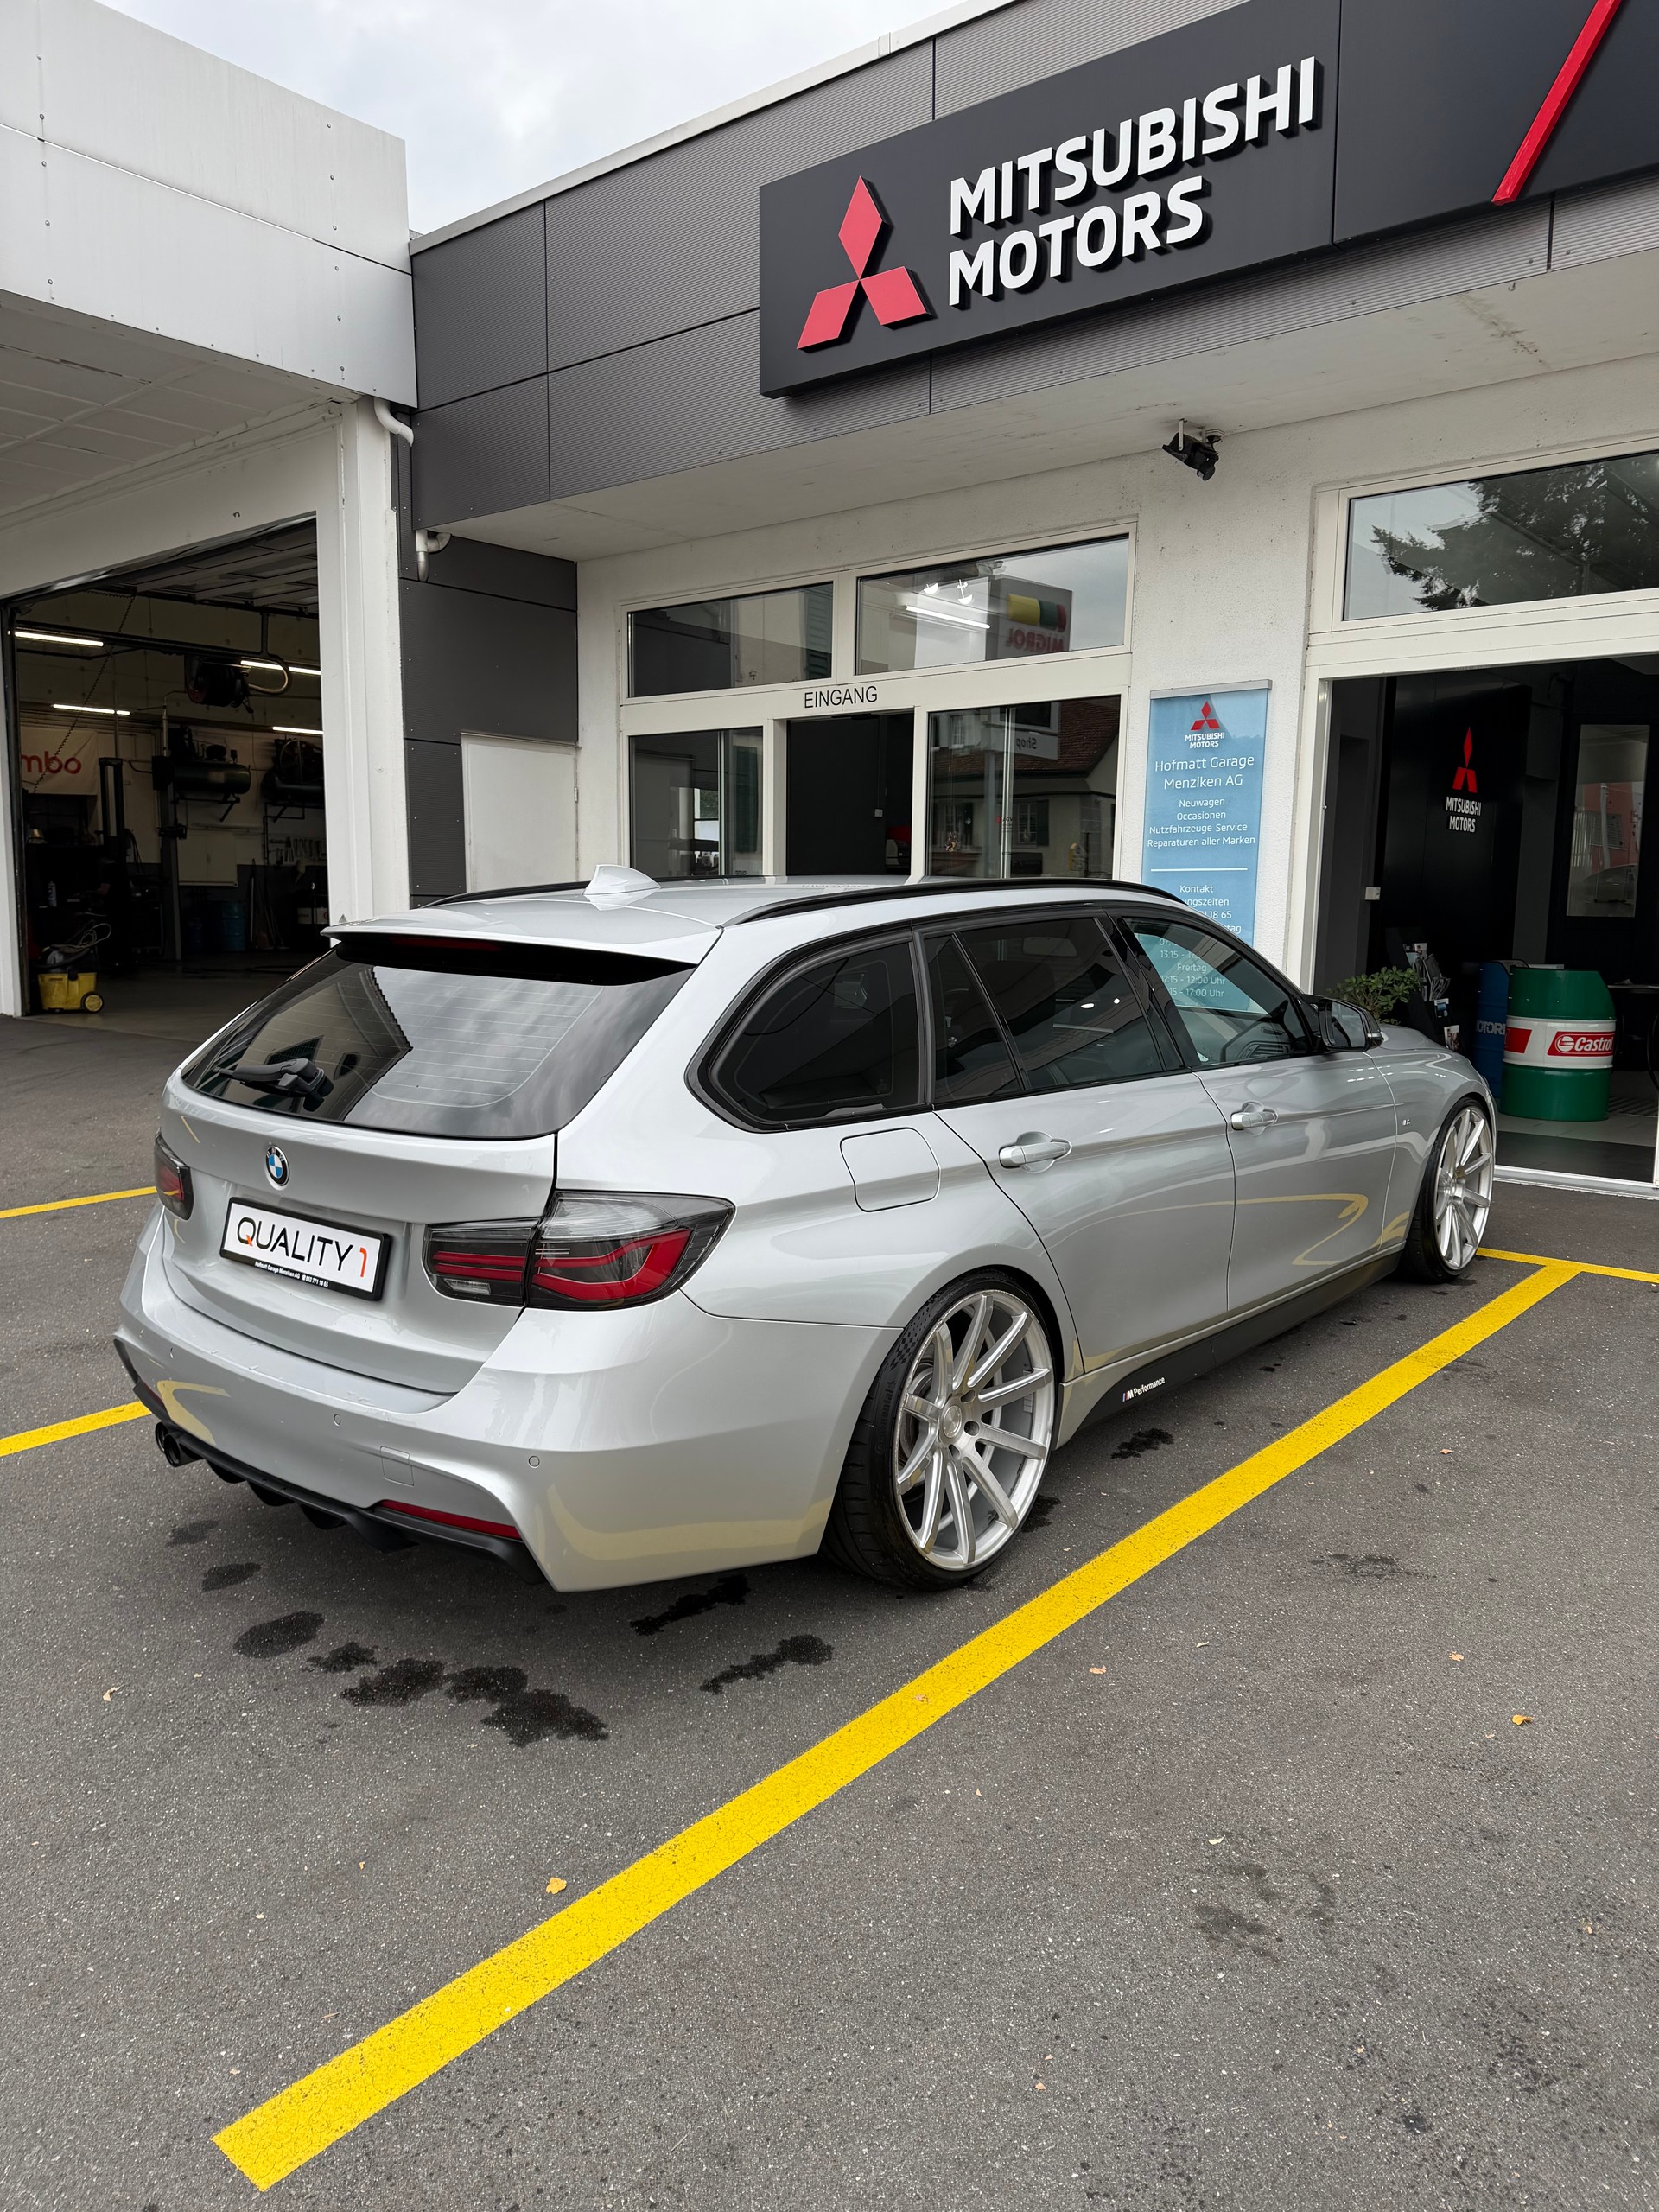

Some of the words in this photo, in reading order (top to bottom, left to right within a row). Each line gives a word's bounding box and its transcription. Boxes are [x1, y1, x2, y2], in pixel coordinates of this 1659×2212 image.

[950, 56, 1317, 236] MITSUBISHI
[949, 176, 1205, 307] MOTORS
[804, 685, 878, 709] EINGANG
[1185, 732, 1225, 741] MITSUBISHI
[1190, 741, 1219, 749] MOTORS
[1155, 758, 1207, 772] Hofmatt
[1210, 756, 1255, 770] Garage
[1164, 776, 1222, 790] Menziken
[1225, 774, 1243, 786] AG
[1179, 798, 1225, 809] Neuwagen
[1446, 796, 1482, 816] MITSUBISHI
[1177, 811, 1226, 821] Occasionen
[1149, 824, 1212, 835] Nutzfahrzeuge
[1215, 823, 1248, 832] Service
[1449, 815, 1476, 833] MOTORS
[1147, 838, 1199, 849] Reparaturen
[1201, 837, 1219, 846] aller
[1223, 836, 1255, 845] Marken
[1179, 885, 1214, 893] Kontakt
[1221, 911, 1232, 919] 65
[1177, 963, 1207, 973] Freitag
[1187, 976, 1208, 984] 12:00
[1211, 976, 1225, 985] Uhr
[1185, 988, 1207, 997] 17:00
[1209, 988, 1224, 997] Uhr
[1476, 1020, 1506, 1035] OTOR
[1574, 1037, 1613, 1052] Castrol
[237, 1217, 354, 1272] QUALITY
[1133, 1377, 1165, 1396] Performance
